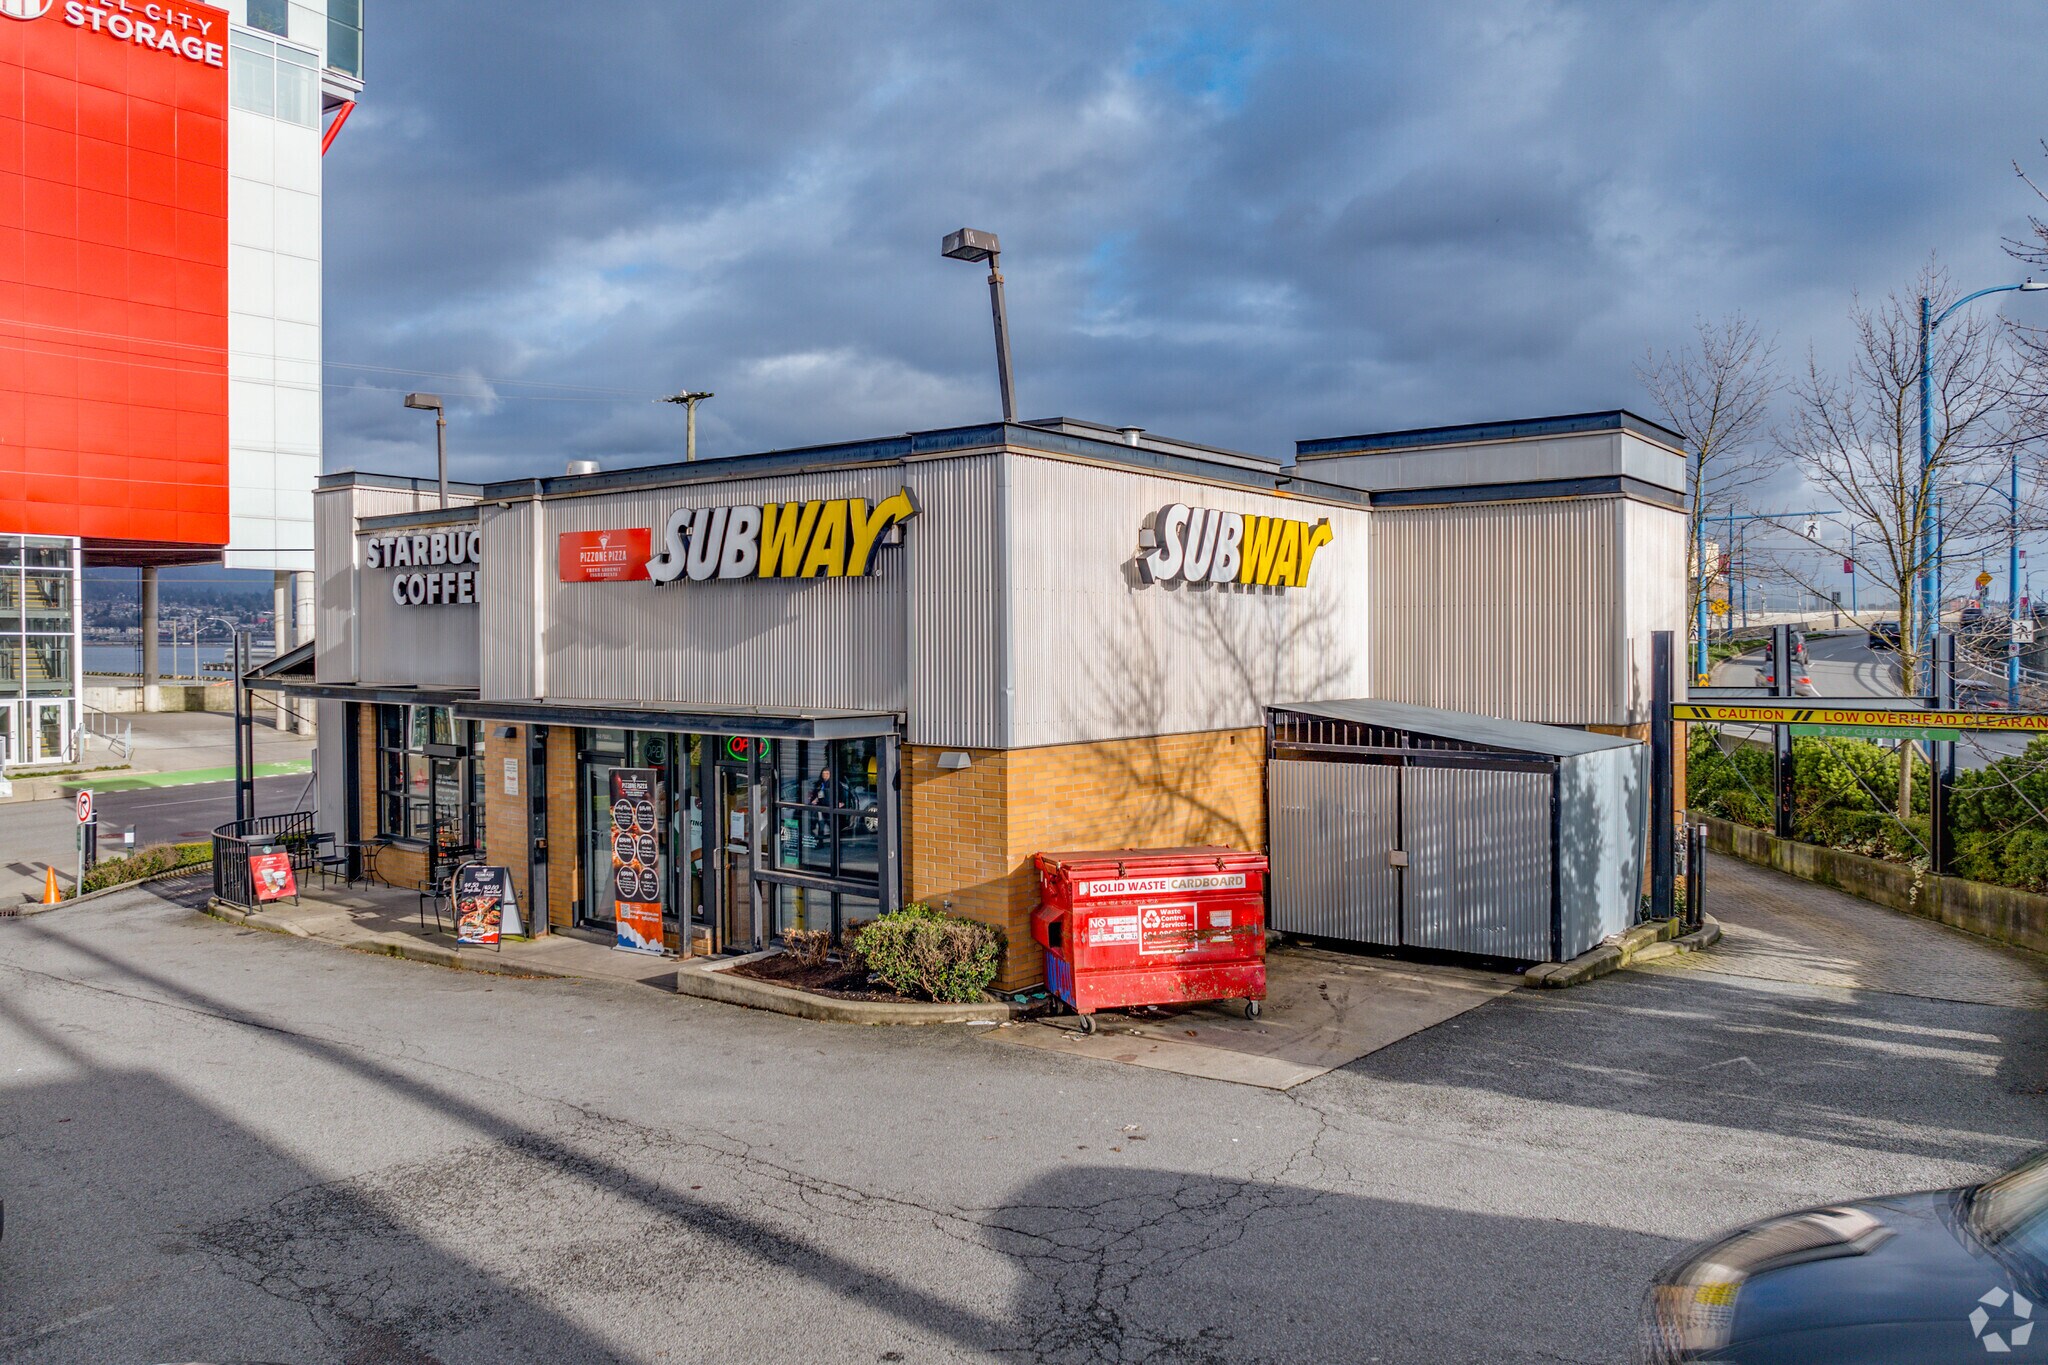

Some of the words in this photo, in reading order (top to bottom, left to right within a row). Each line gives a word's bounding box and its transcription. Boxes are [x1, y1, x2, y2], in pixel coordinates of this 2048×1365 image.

[144, 3, 213, 36] CITY
[64, 1, 224, 67] STORAGE
[646, 486, 920, 585] SUBWAY
[1142, 503, 1333, 588] SUBWAY
[580, 551, 607, 563] PIZZONE
[608, 550, 627, 562] PIZZA
[1717, 708, 1784, 720] CAUTION
[1824, 711, 1859, 723] LOW
[1864, 712, 1957, 725] OVERHEAD
[1854, 728, 1916, 738] CLEARANCE
[731, 737, 764, 753] OP
[1092, 882, 1125, 893] SOLID
[1128, 880, 1166, 891] WASTE
[1171, 876, 1243, 889] CARDBOARD
[1161, 914, 1186, 922] Control
